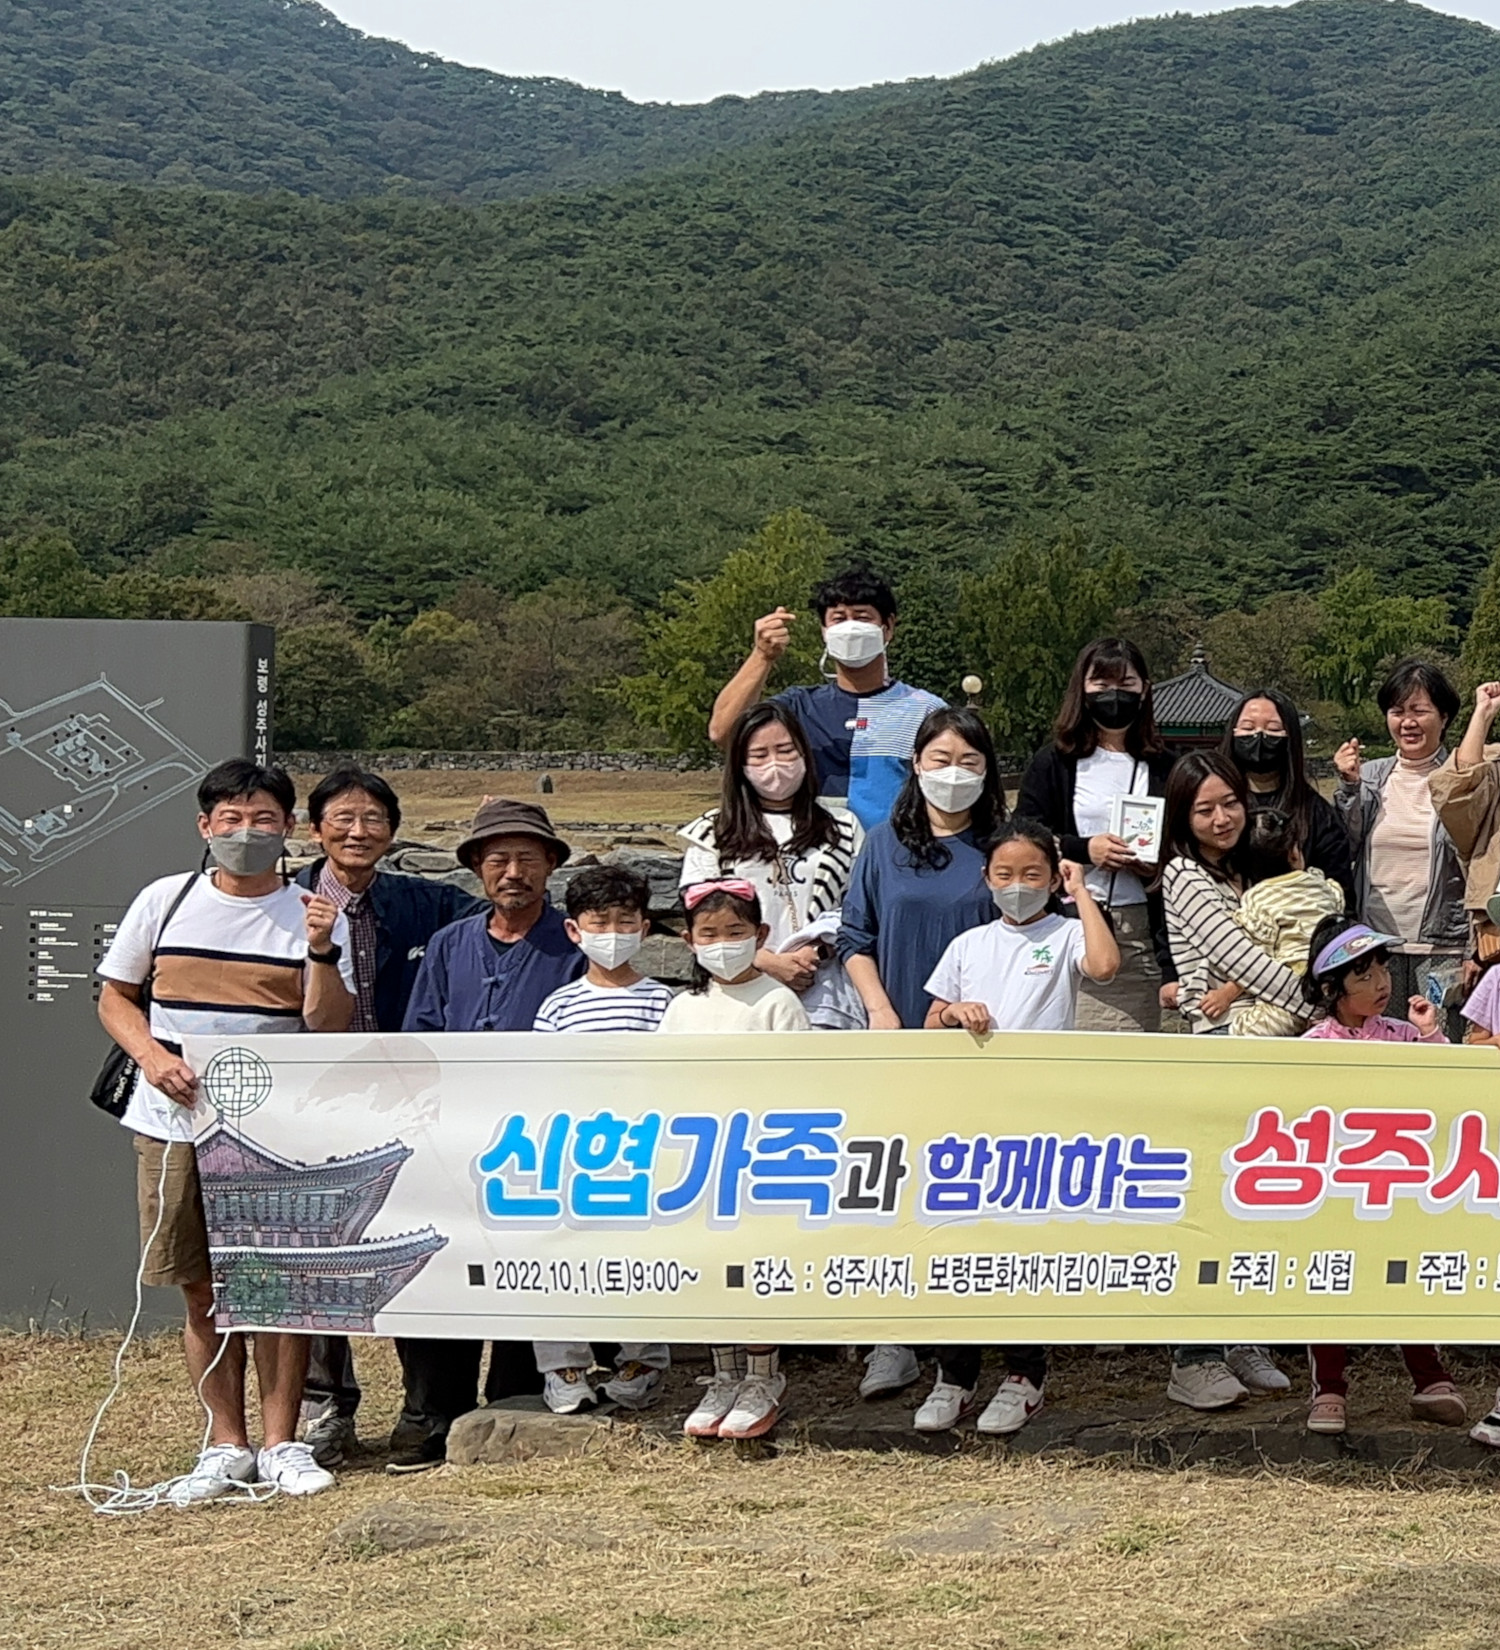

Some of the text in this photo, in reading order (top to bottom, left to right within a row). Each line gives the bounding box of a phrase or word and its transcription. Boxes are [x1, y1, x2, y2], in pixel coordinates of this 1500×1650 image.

[255, 658, 269, 768] 보령 성주사지
[925, 1136, 1189, 1212] 함께하는
[752, 1257, 796, 1296] 장소
[823, 1256, 917, 1296] 성주사지,
[927, 1254, 1177, 1294] 보령문화재지킴이교육장
[1229, 1253, 1276, 1292] 주최
[1307, 1252, 1351, 1291] 신협
[1419, 1253, 1467, 1292] 주관
